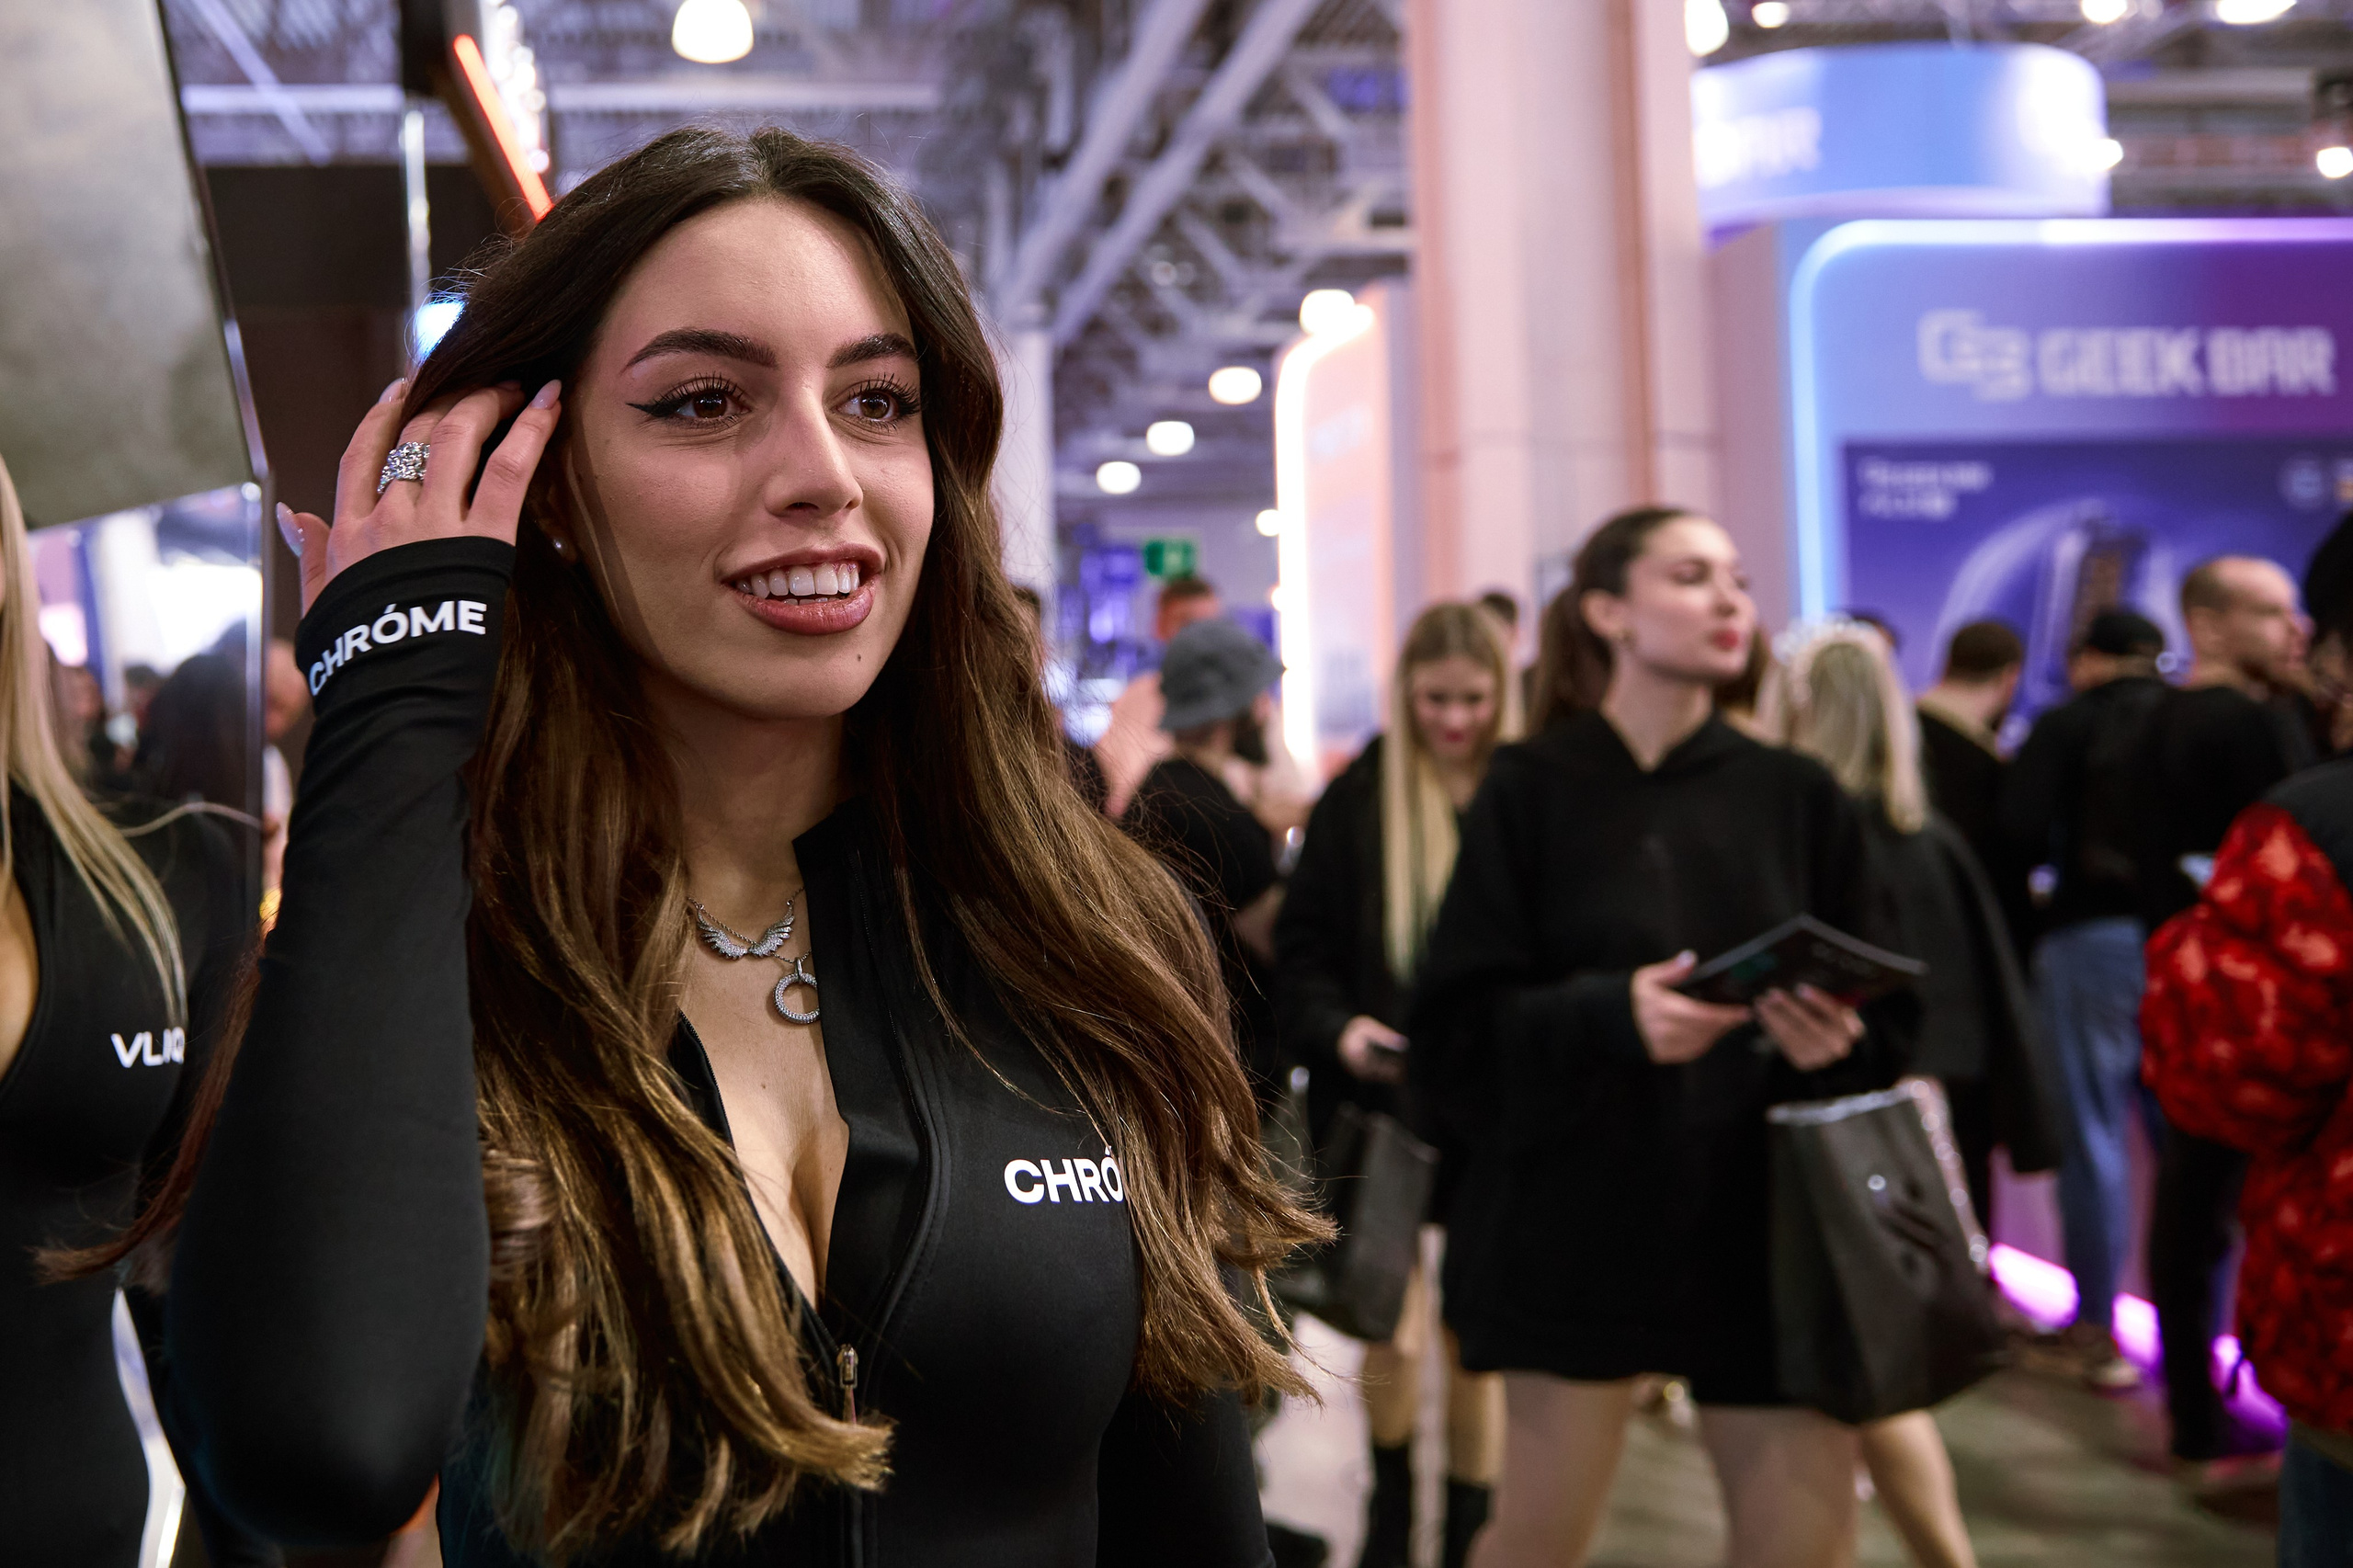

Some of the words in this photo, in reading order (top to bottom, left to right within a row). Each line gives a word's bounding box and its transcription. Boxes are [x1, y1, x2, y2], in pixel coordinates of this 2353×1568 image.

[2040, 328, 2204, 396] GEEK
[2208, 328, 2336, 396] BAR
[309, 599, 487, 696] CHRÓME
[1004, 1146, 1124, 1204] CHRÓ
